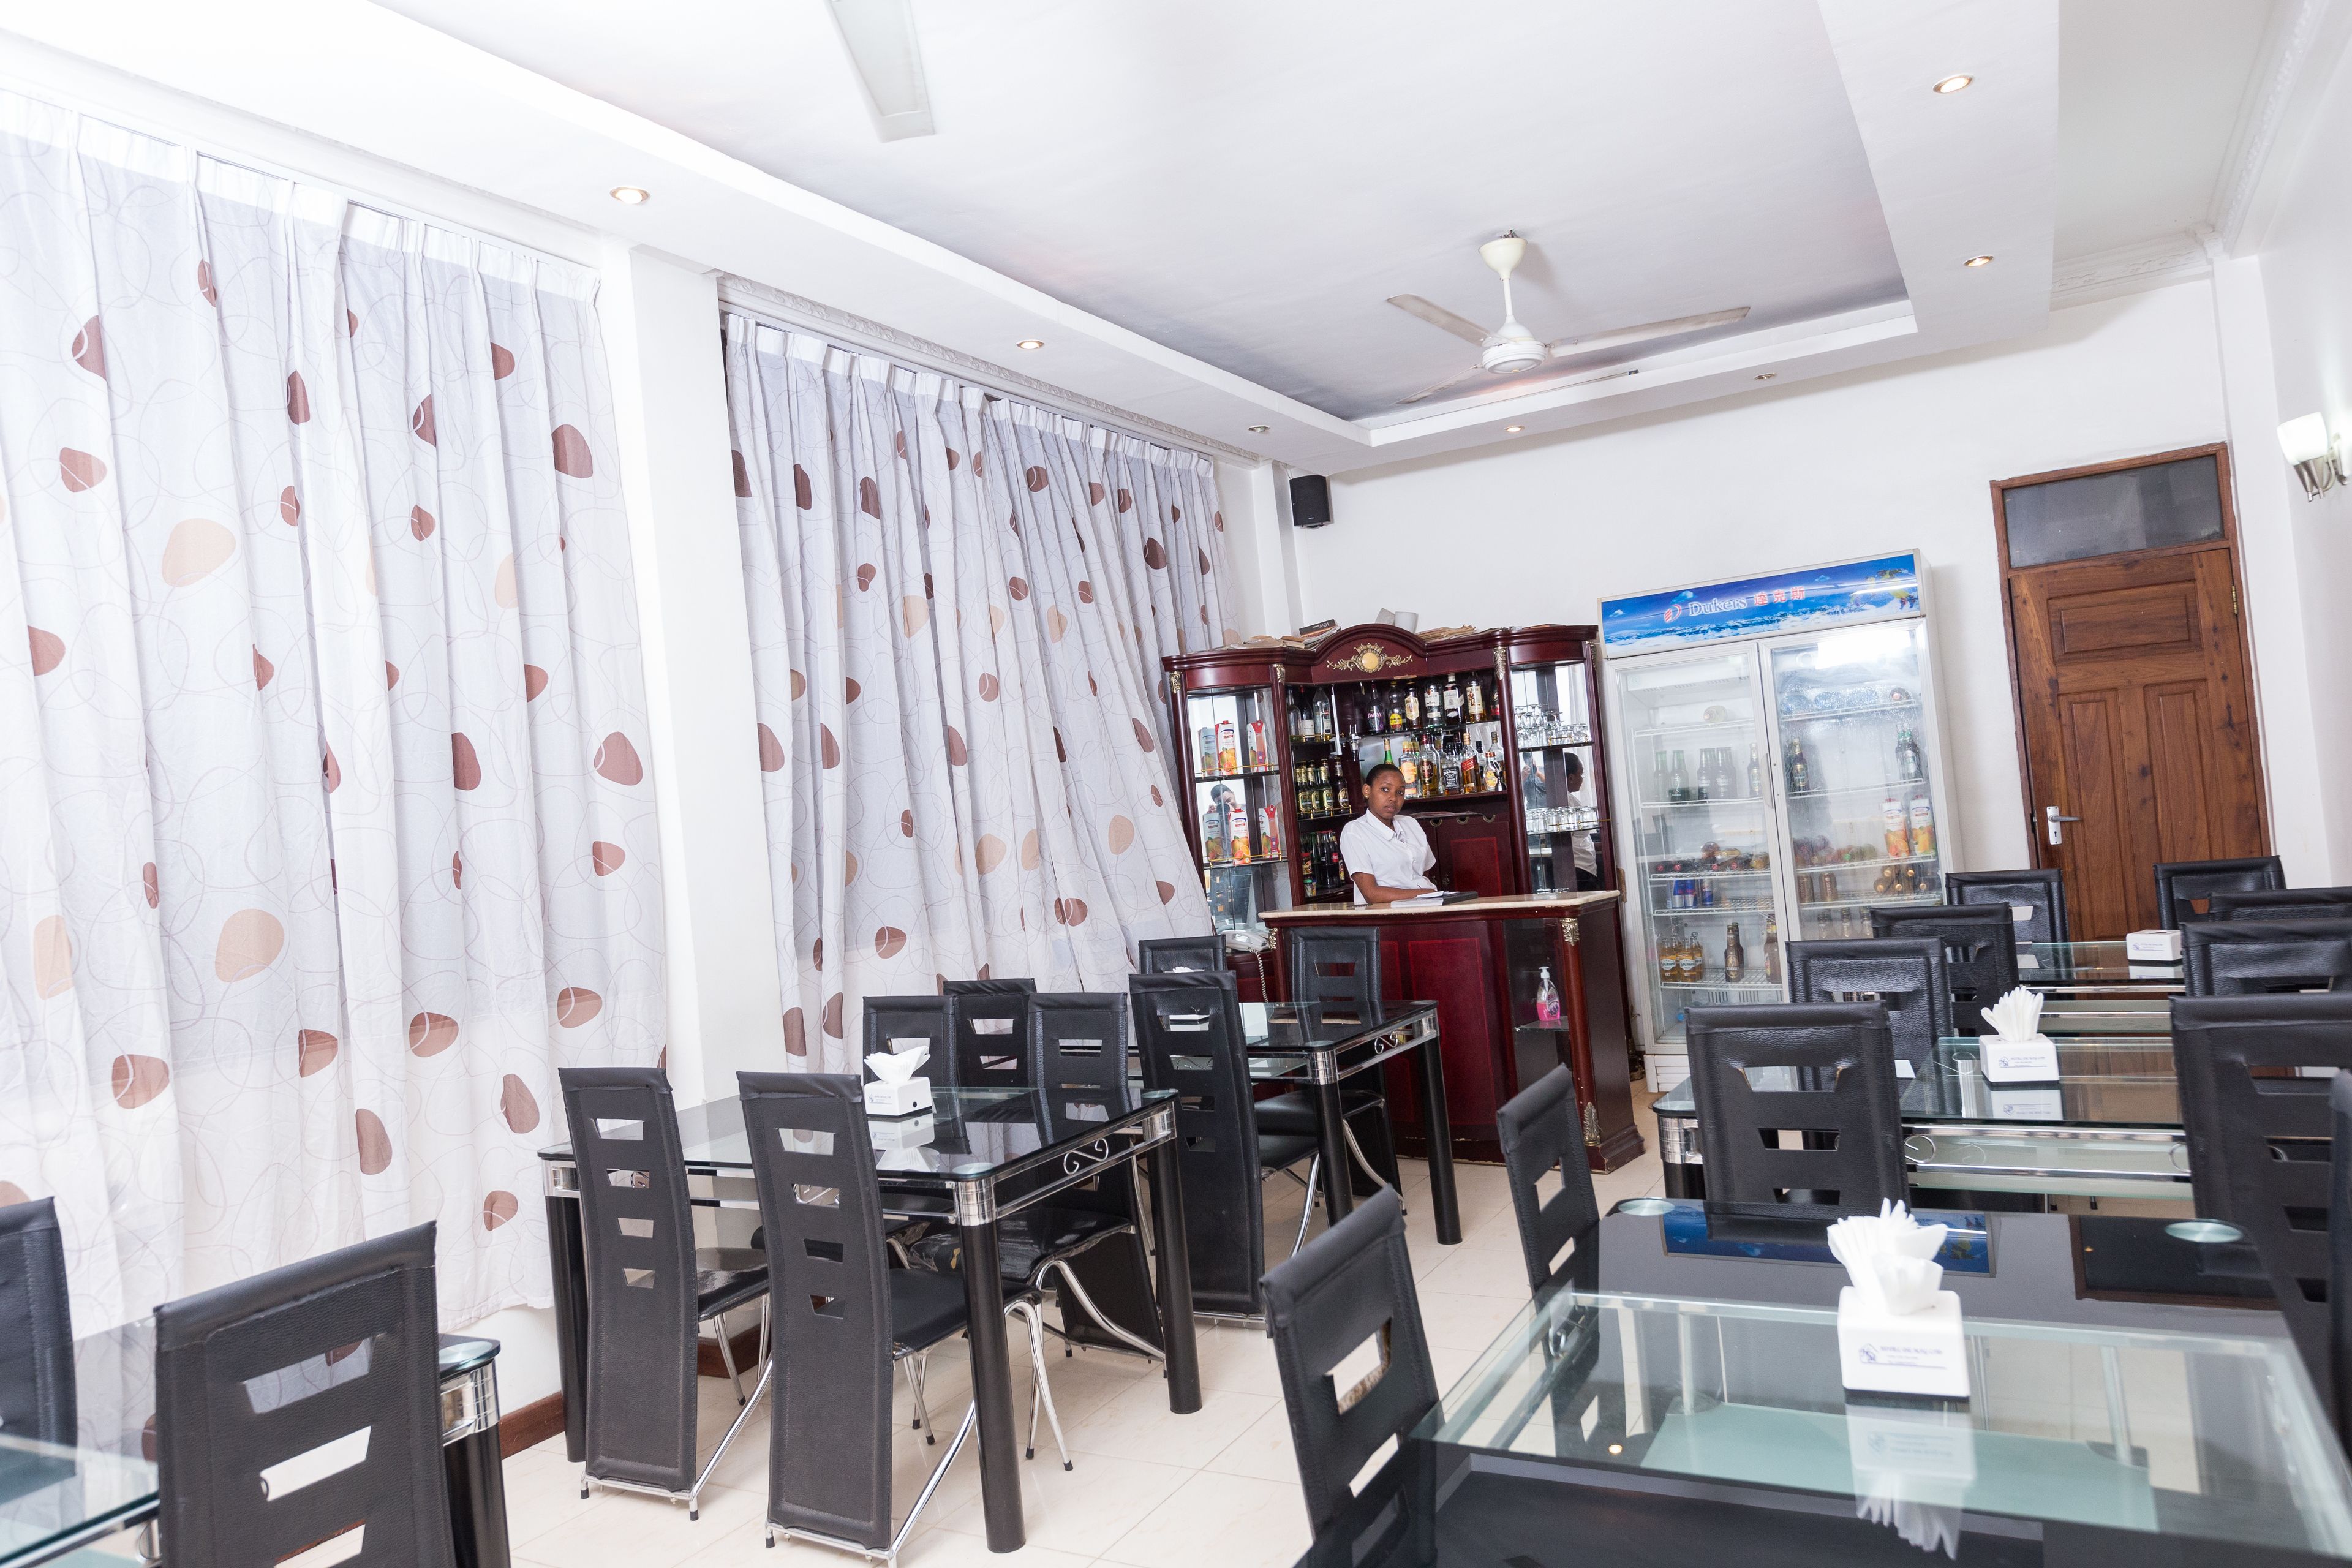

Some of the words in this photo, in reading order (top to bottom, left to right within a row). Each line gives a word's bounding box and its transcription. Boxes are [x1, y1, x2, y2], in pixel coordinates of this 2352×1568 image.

[1754, 586, 1806, 606] 達克斯
[1689, 598, 1747, 616] Dukers
